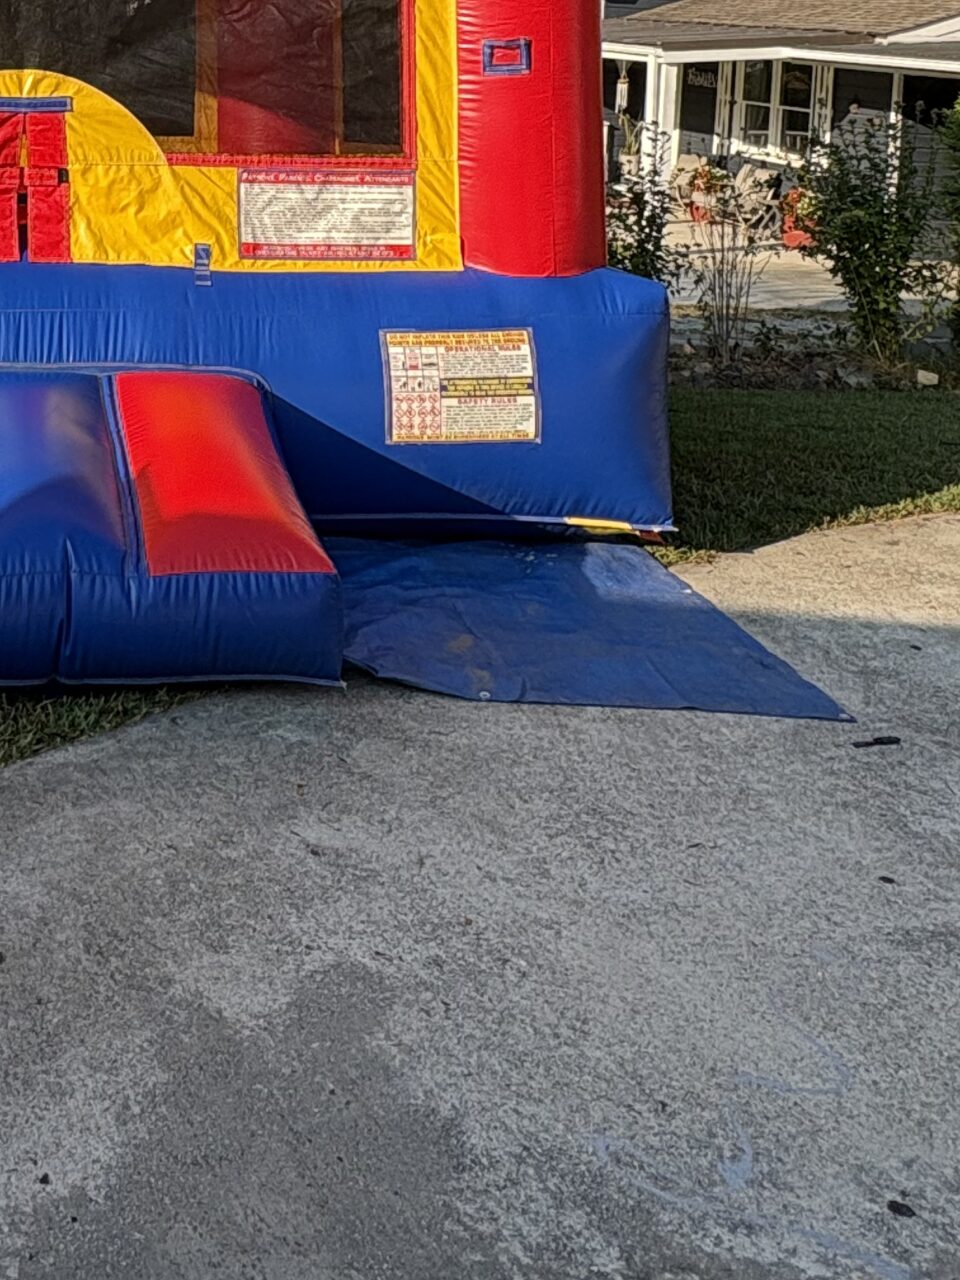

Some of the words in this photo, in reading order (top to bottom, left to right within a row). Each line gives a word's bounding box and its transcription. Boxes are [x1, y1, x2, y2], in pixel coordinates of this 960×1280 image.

[444, 345, 496, 353] OPERATIONAL
[498, 344, 522, 352] RULES
[457, 397, 488, 405] SAFETY
[491, 396, 518, 404] RULES
